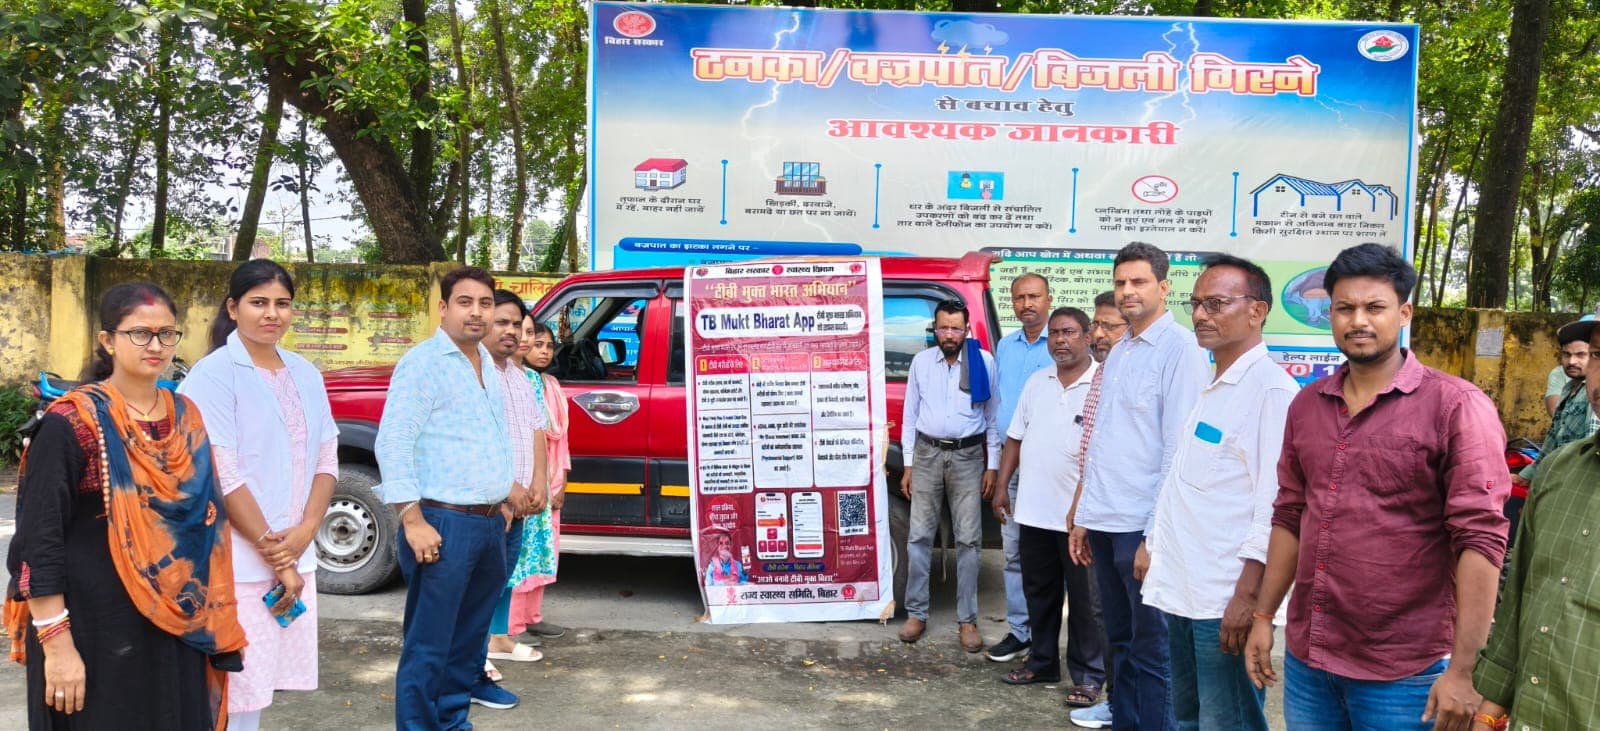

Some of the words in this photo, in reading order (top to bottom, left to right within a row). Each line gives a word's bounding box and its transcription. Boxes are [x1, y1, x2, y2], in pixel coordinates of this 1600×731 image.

[604, 35, 631, 46] बिहार
[1189, 52, 1320, 96] गिरने
[935, 96, 959, 111] से
[964, 99, 1032, 112] बचाव
[1036, 98, 1075, 117] हेतु
[828, 119, 1000, 141] आवश्यक
[1003, 121, 1181, 145] जानकारी
[648, 195, 658, 203] के
[960, 203, 990, 212] बिजली
[1154, 208, 1171, 216] लोहे
[957, 211, 970, 220] को
[1280, 211, 1297, 219] टीन
[935, 218, 972, 228] टेलीफोन
[1252, 227, 1276, 235] किसी
[1280, 228, 1312, 237] सुरक्षित
[712, 243, 735, 251] लगने
[1015, 250, 1037, 258] आप
[725, 266, 744, 274] बिहार
[742, 285, 766, 303] मुक्त
[770, 284, 798, 298] भारत
[701, 314, 716, 330] TB
[721, 312, 750, 329] Mukt
[753, 311, 789, 329] Bharat
[793, 312, 815, 332] App
[1282, 352, 1306, 361] हेल्प
[817, 587, 838, 598] बिहार
